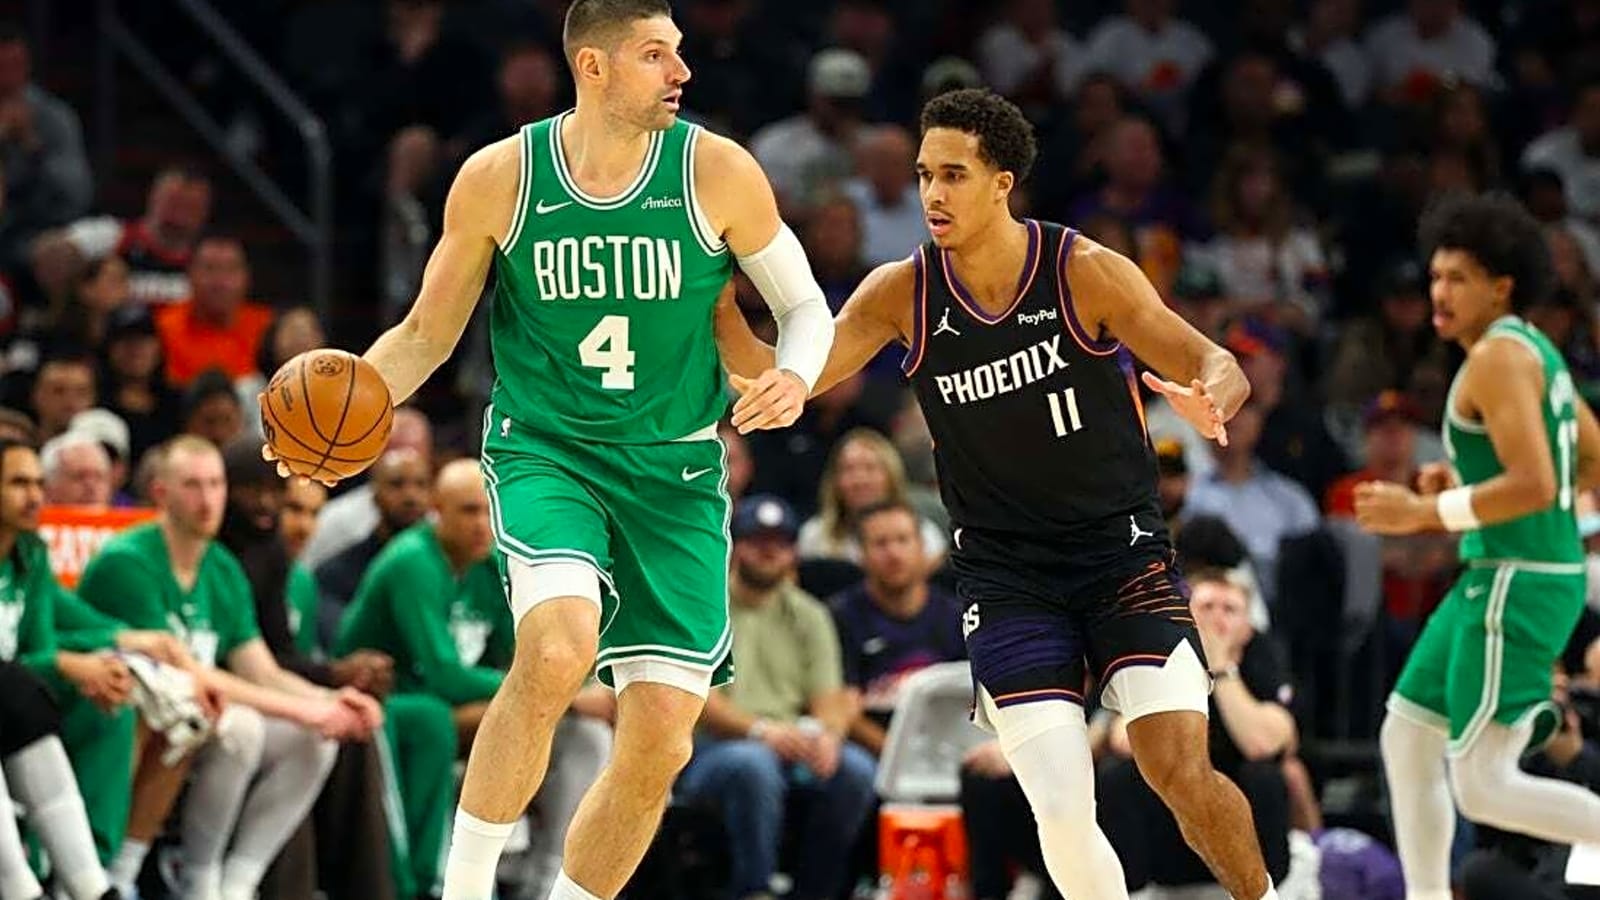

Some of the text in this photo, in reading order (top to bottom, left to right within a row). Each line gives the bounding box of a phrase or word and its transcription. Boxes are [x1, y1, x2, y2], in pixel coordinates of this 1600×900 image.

[640, 196, 682, 209] Amica
[533, 236, 682, 300] BOSTON
[1017, 308, 1057, 325] PayPal
[578, 315, 636, 390] 4
[934, 334, 1070, 405] PHOENIX
[1047, 387, 1083, 438] 11
